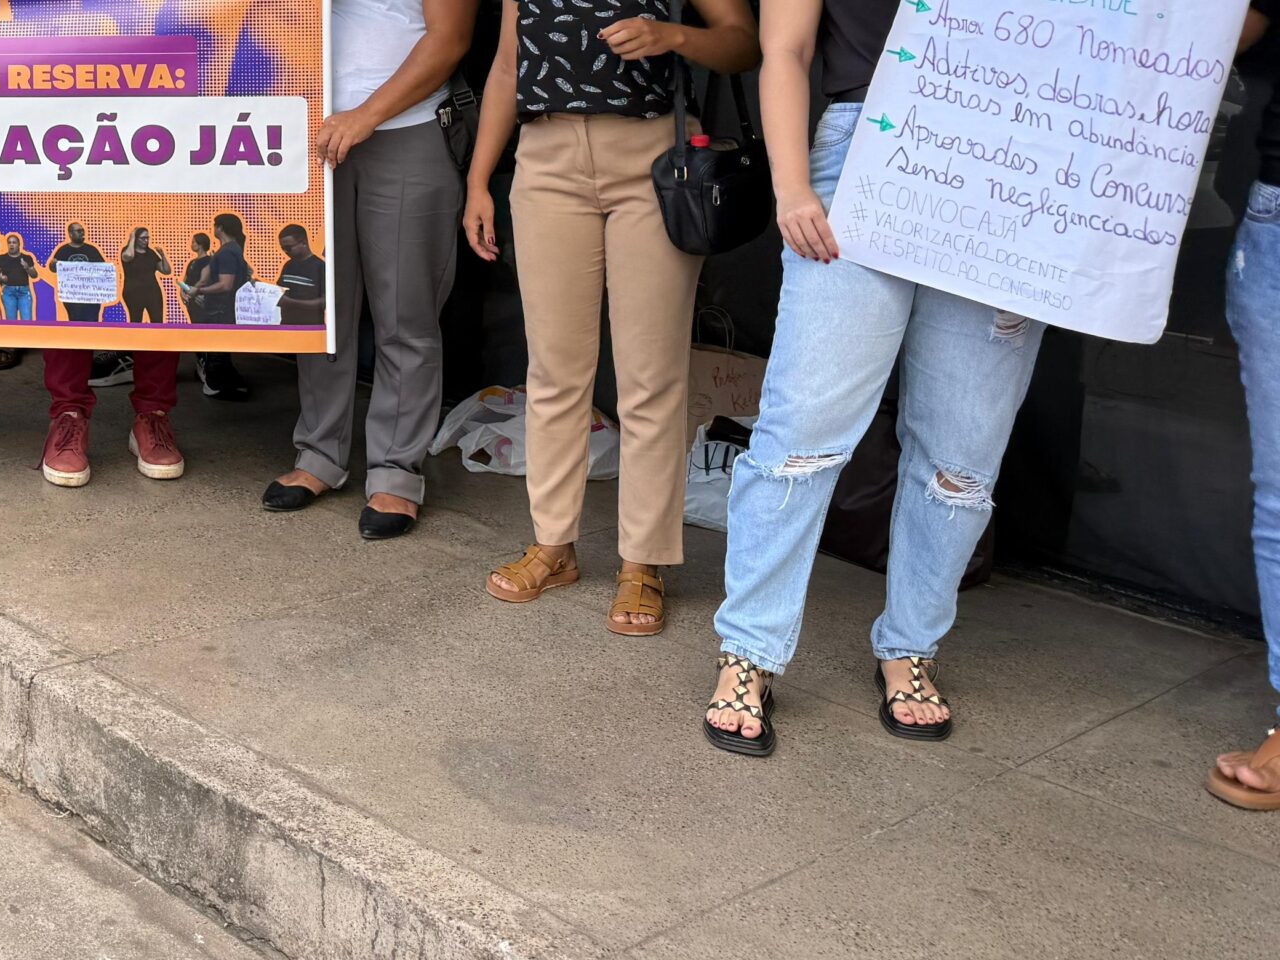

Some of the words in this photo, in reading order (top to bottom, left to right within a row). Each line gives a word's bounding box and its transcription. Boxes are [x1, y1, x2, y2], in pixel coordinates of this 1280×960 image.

[994, 11, 1055, 48] 680
[7, 63, 186, 90] RESERVA:
[914, 36, 1030, 99] Aditivos,
[909, 75, 1001, 116] extras
[1010, 102, 1053, 132] em
[189, 112, 283, 167] JÁ!
[894, 104, 1038, 175] Aprovados
[1056, 152, 1081, 189] do
